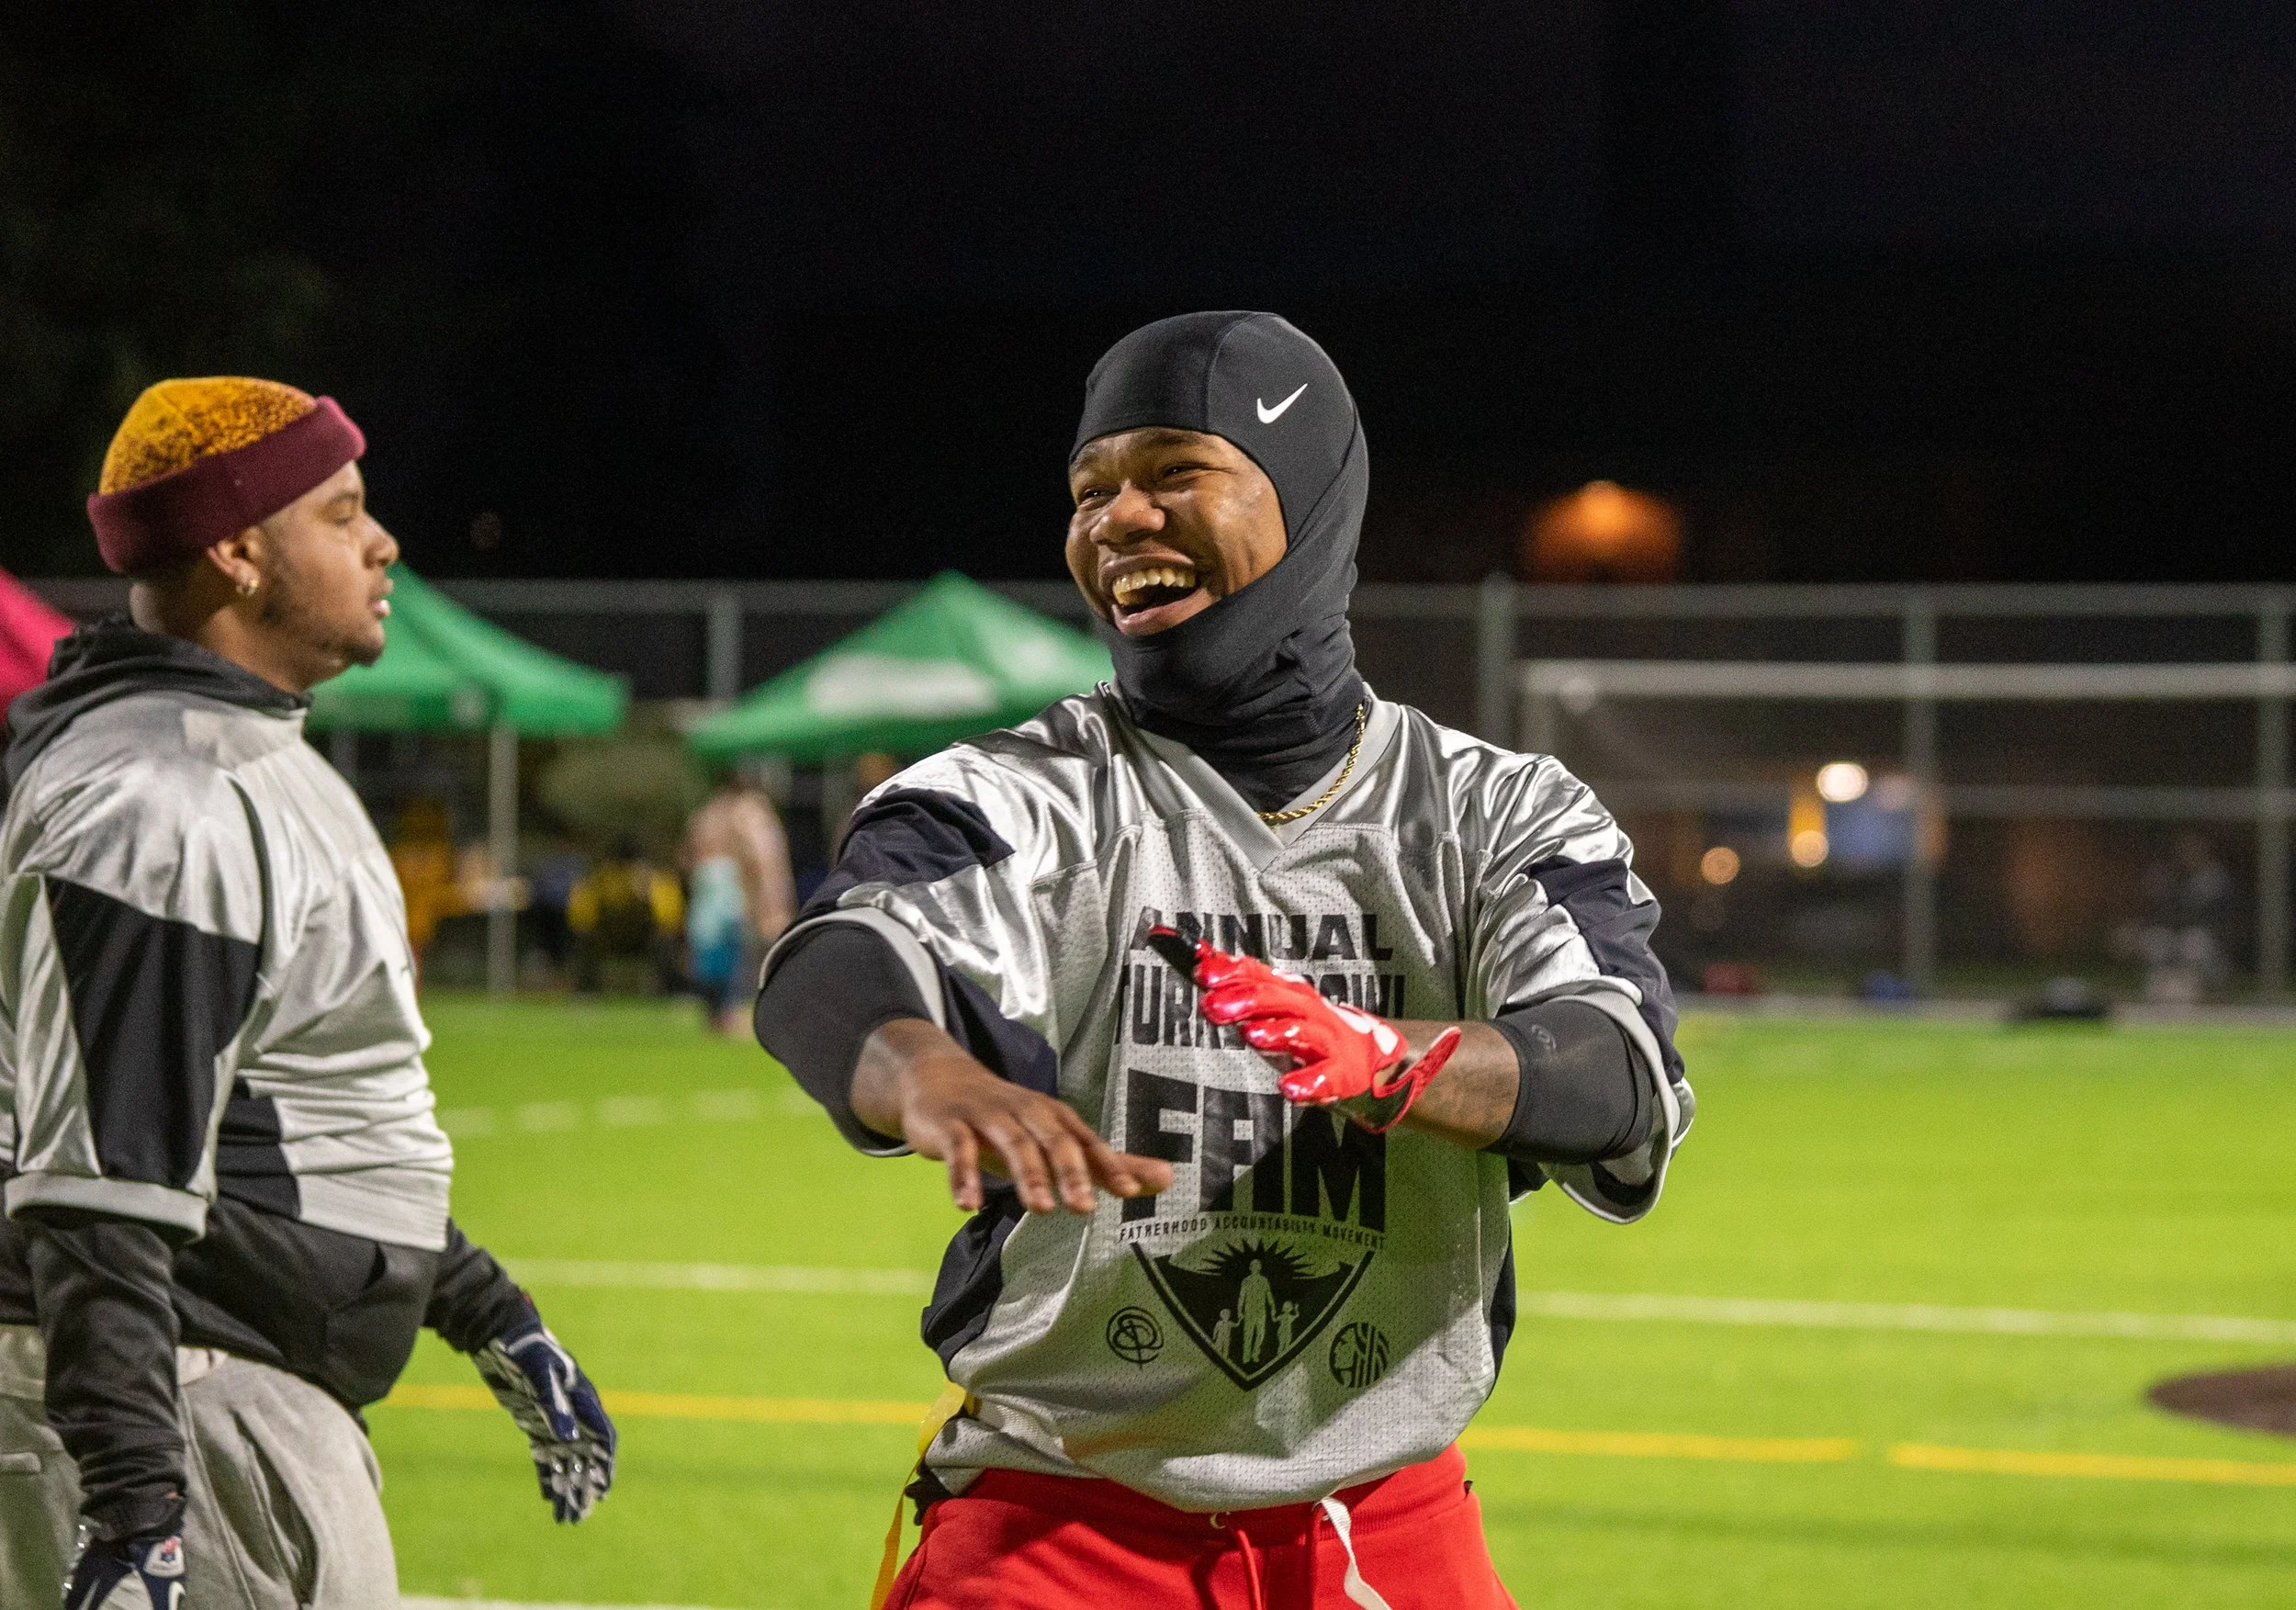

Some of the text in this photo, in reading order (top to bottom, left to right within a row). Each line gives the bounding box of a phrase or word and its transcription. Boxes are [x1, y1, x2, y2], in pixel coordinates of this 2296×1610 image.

[1120, 1068, 1387, 1233] FAM
[1118, 1217, 1208, 1243] FATHERHOOD
[1322, 1224, 1387, 1250] MOVEMENT
